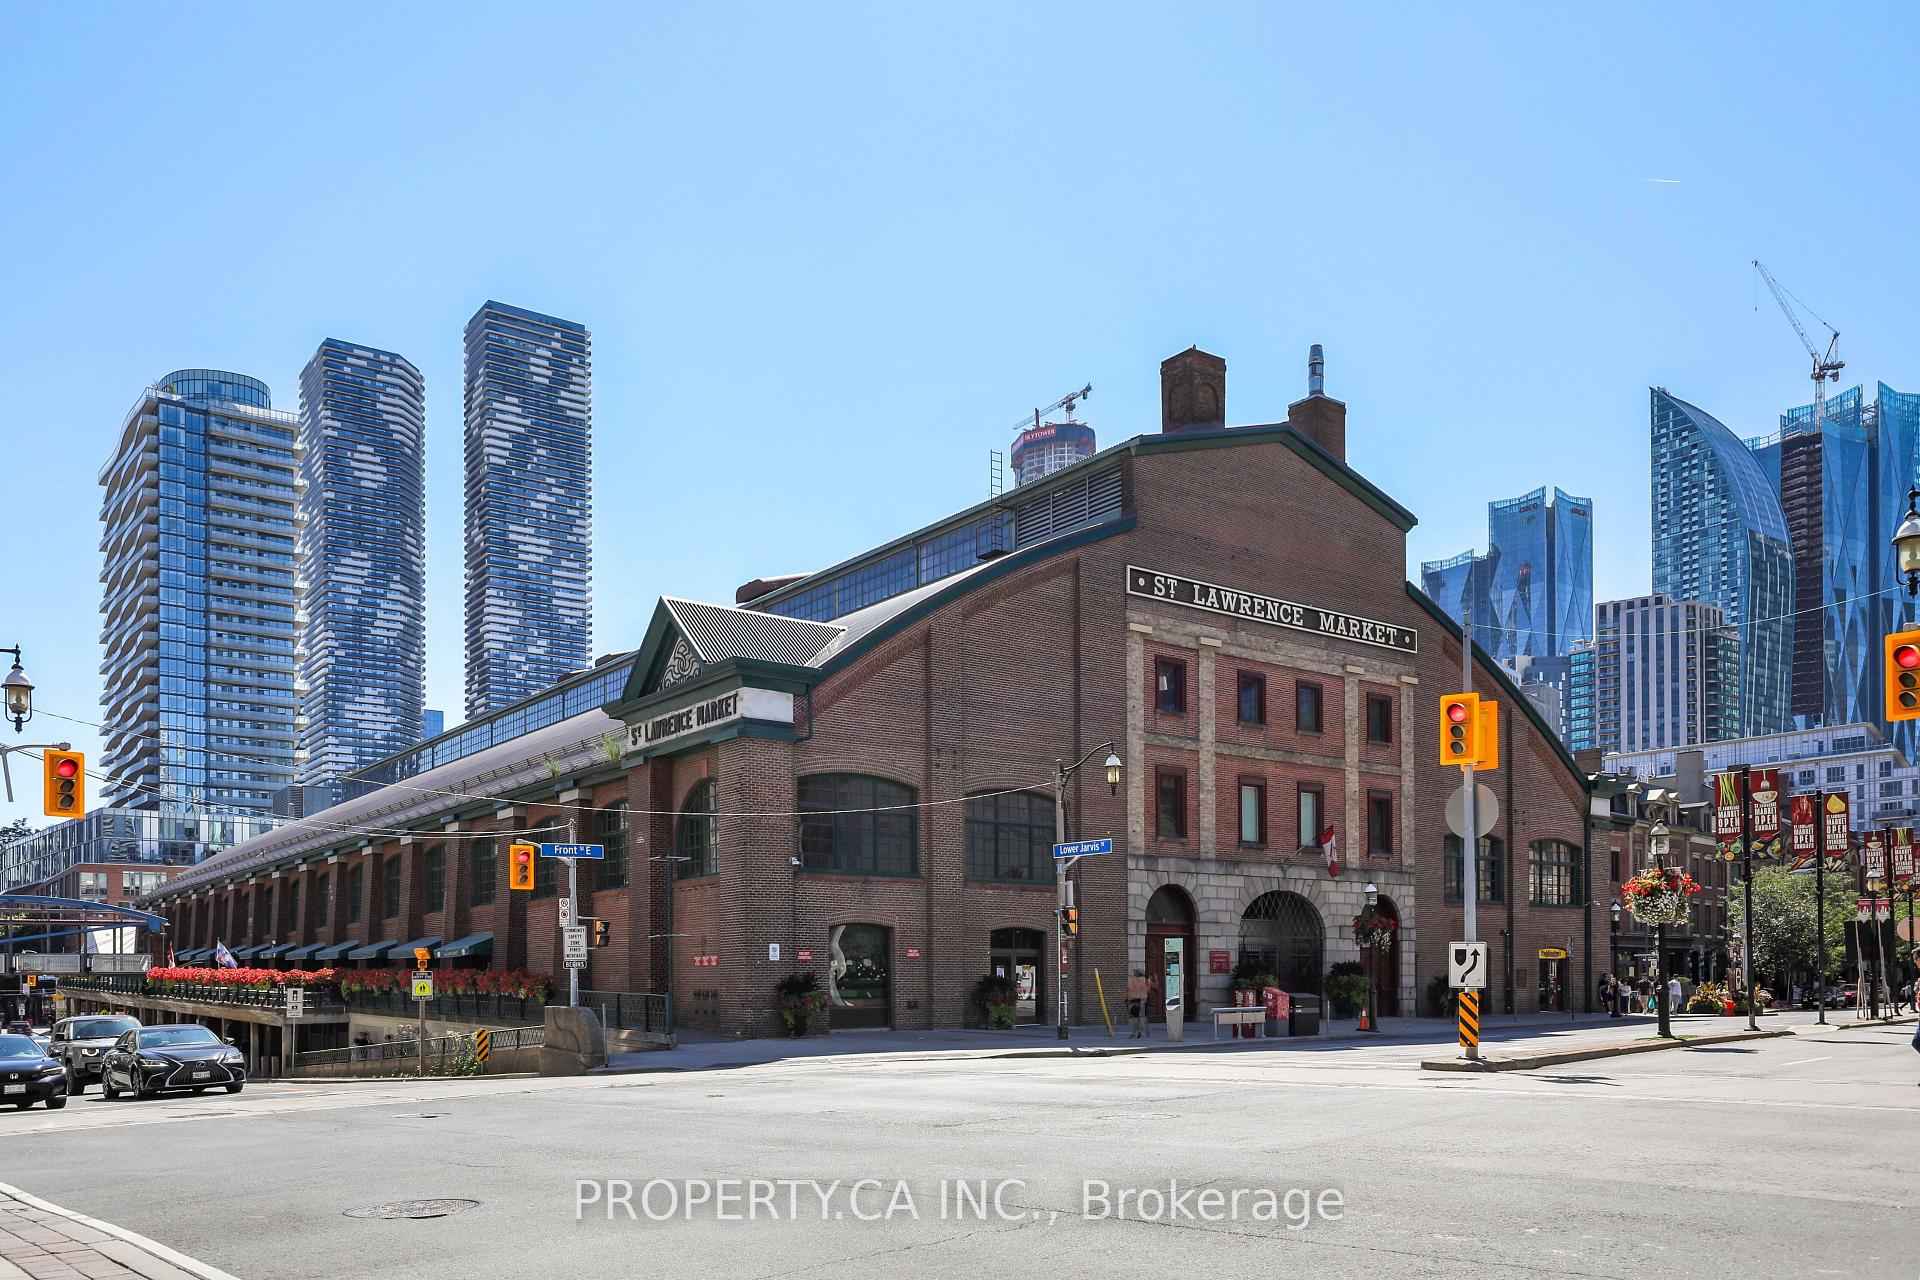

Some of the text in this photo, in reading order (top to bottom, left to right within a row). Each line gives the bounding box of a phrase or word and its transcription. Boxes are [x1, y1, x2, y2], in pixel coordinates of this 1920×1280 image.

[1024, 428, 1056, 441] SKYTOWER
[1193, 584, 1303, 626] LAWRENCE
[1319, 611, 1398, 646] MARKET
[644, 709, 694, 743] LAWRENCE
[696, 692, 739, 727] MARKET
[1718, 810, 1740, 818] MARKET
[1754, 807, 1776, 816] MARKET
[1718, 817, 1740, 828] OPEN
[1754, 815, 1777, 825] OPEN
[1826, 817, 1847, 826] MARKET
[1793, 827, 1814, 836] MARKET
[1826, 824, 1847, 834] OPEN
[1793, 834, 1814, 844] OPEN
[554, 845, 578, 855] Front
[585, 846, 592, 855] E
[1060, 846, 1079, 854] Lower
[1080, 842, 1100, 852] Jarvis
[1866, 855, 1884, 865] OPEN
[1895, 853, 1912, 862] OPEN
